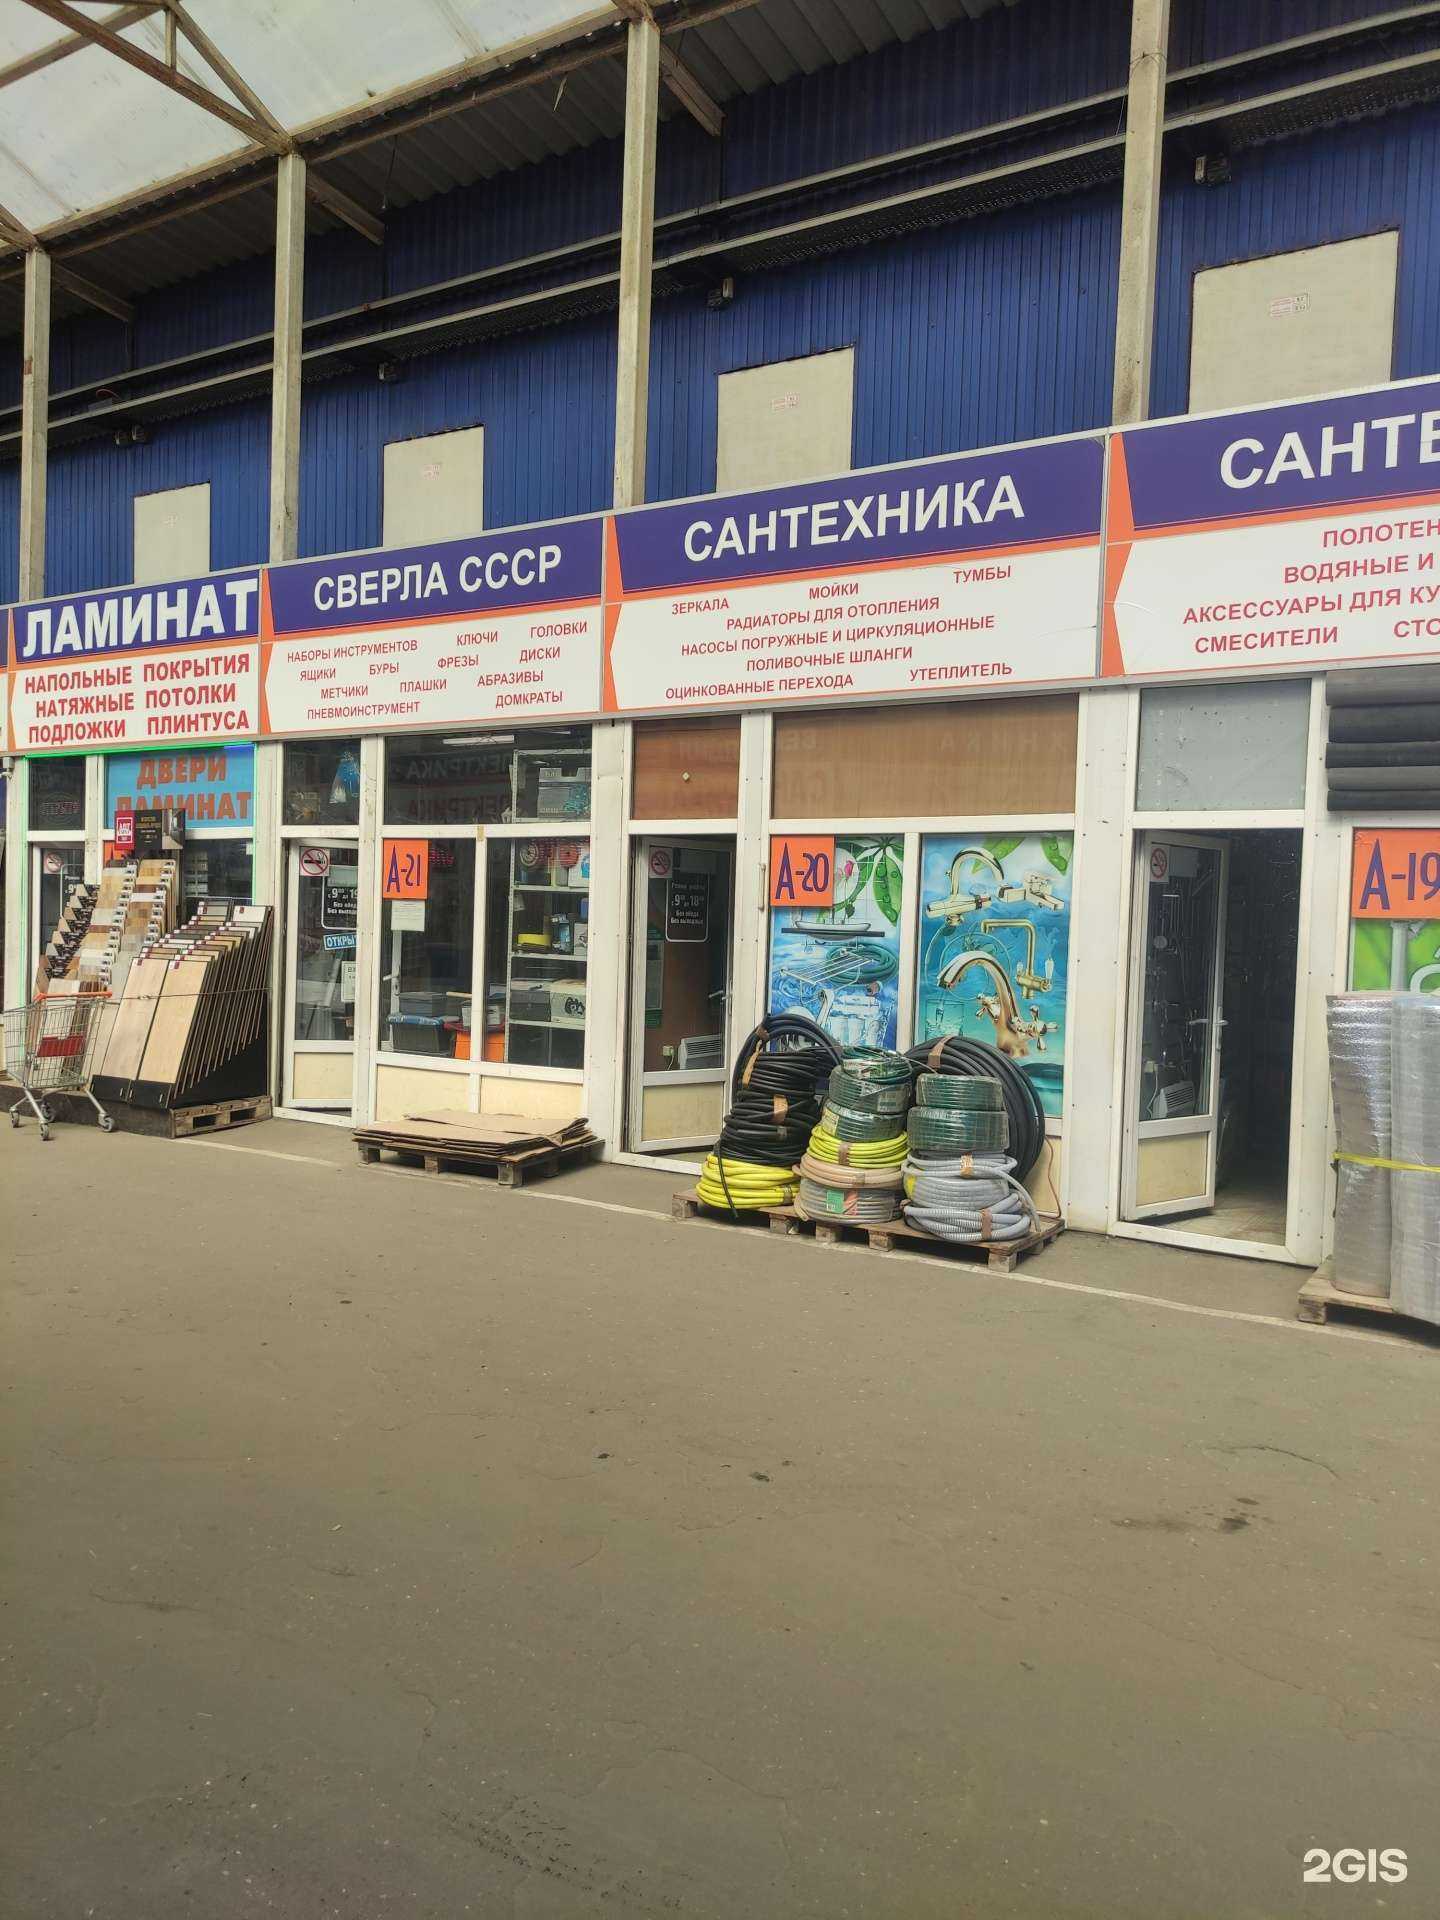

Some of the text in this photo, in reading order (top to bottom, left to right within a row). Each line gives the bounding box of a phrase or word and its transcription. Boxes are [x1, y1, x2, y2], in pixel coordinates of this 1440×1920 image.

[683, 475, 1025, 562] САНТЕХНИКА
[1322, 520, 1440, 548] ПОЛОТЕН
[314, 544, 562, 611] СВЕРЛА СССР
[1284, 552, 1434, 584] ВОДЯНЫЕ И
[671, 564, 1012, 615] ЗЕРКАЛА МОЙКИ ТУМБЫ
[1183, 593, 1342, 624] АКСЕССУАРЫ
[1349, 588, 1401, 613] ДЛЯ
[22, 578, 258, 657] ЛАМИНАТ
[726, 596, 940, 630] РАДИАТОРЫ ДЛЯ ОТОПЛЕНИЯ
[287, 621, 588, 664] НАБОРЫ ИНСТРУМЕНТОВ КЛЮЧИ ГОЛОВКИ
[681, 615, 995, 656] НАСОСЫ ПОГРУЖНЫЕ И ЦИРКУЛЯЦИОННЫЕ
[1195, 618, 1440, 654] СМЕСИТЕЛИ СТО
[25, 653, 250, 694] НАПОЛЬНЫЕ ПОКРЫТИЯ
[299, 646, 561, 682] ЯЩИКИ БУРЫ ФРЕЗЫ ДИСКИ
[746, 646, 913, 672] ПОЛИВОЧНЫЕ ШЛАНГИ
[320, 670, 544, 699] МЕТЧИКИ ПЛАШКИ АБРАЗИВЫ
[665, 662, 1013, 700] ОЦИНКОВАННЫЕ ПЕРЕХОДА УТЕПЛИТЕЛЬ
[36, 683, 236, 718] НАТЯЖНЫЕ ПОТОЛКИ
[307, 691, 563, 720] ПНЕВМОИНСТРУМЕНТ ДОМКРАТЫ
[28, 710, 250, 745] ПОДЛОЖКИ ПЛИНТУСА
[137, 753, 226, 790] ДВЕРИ
